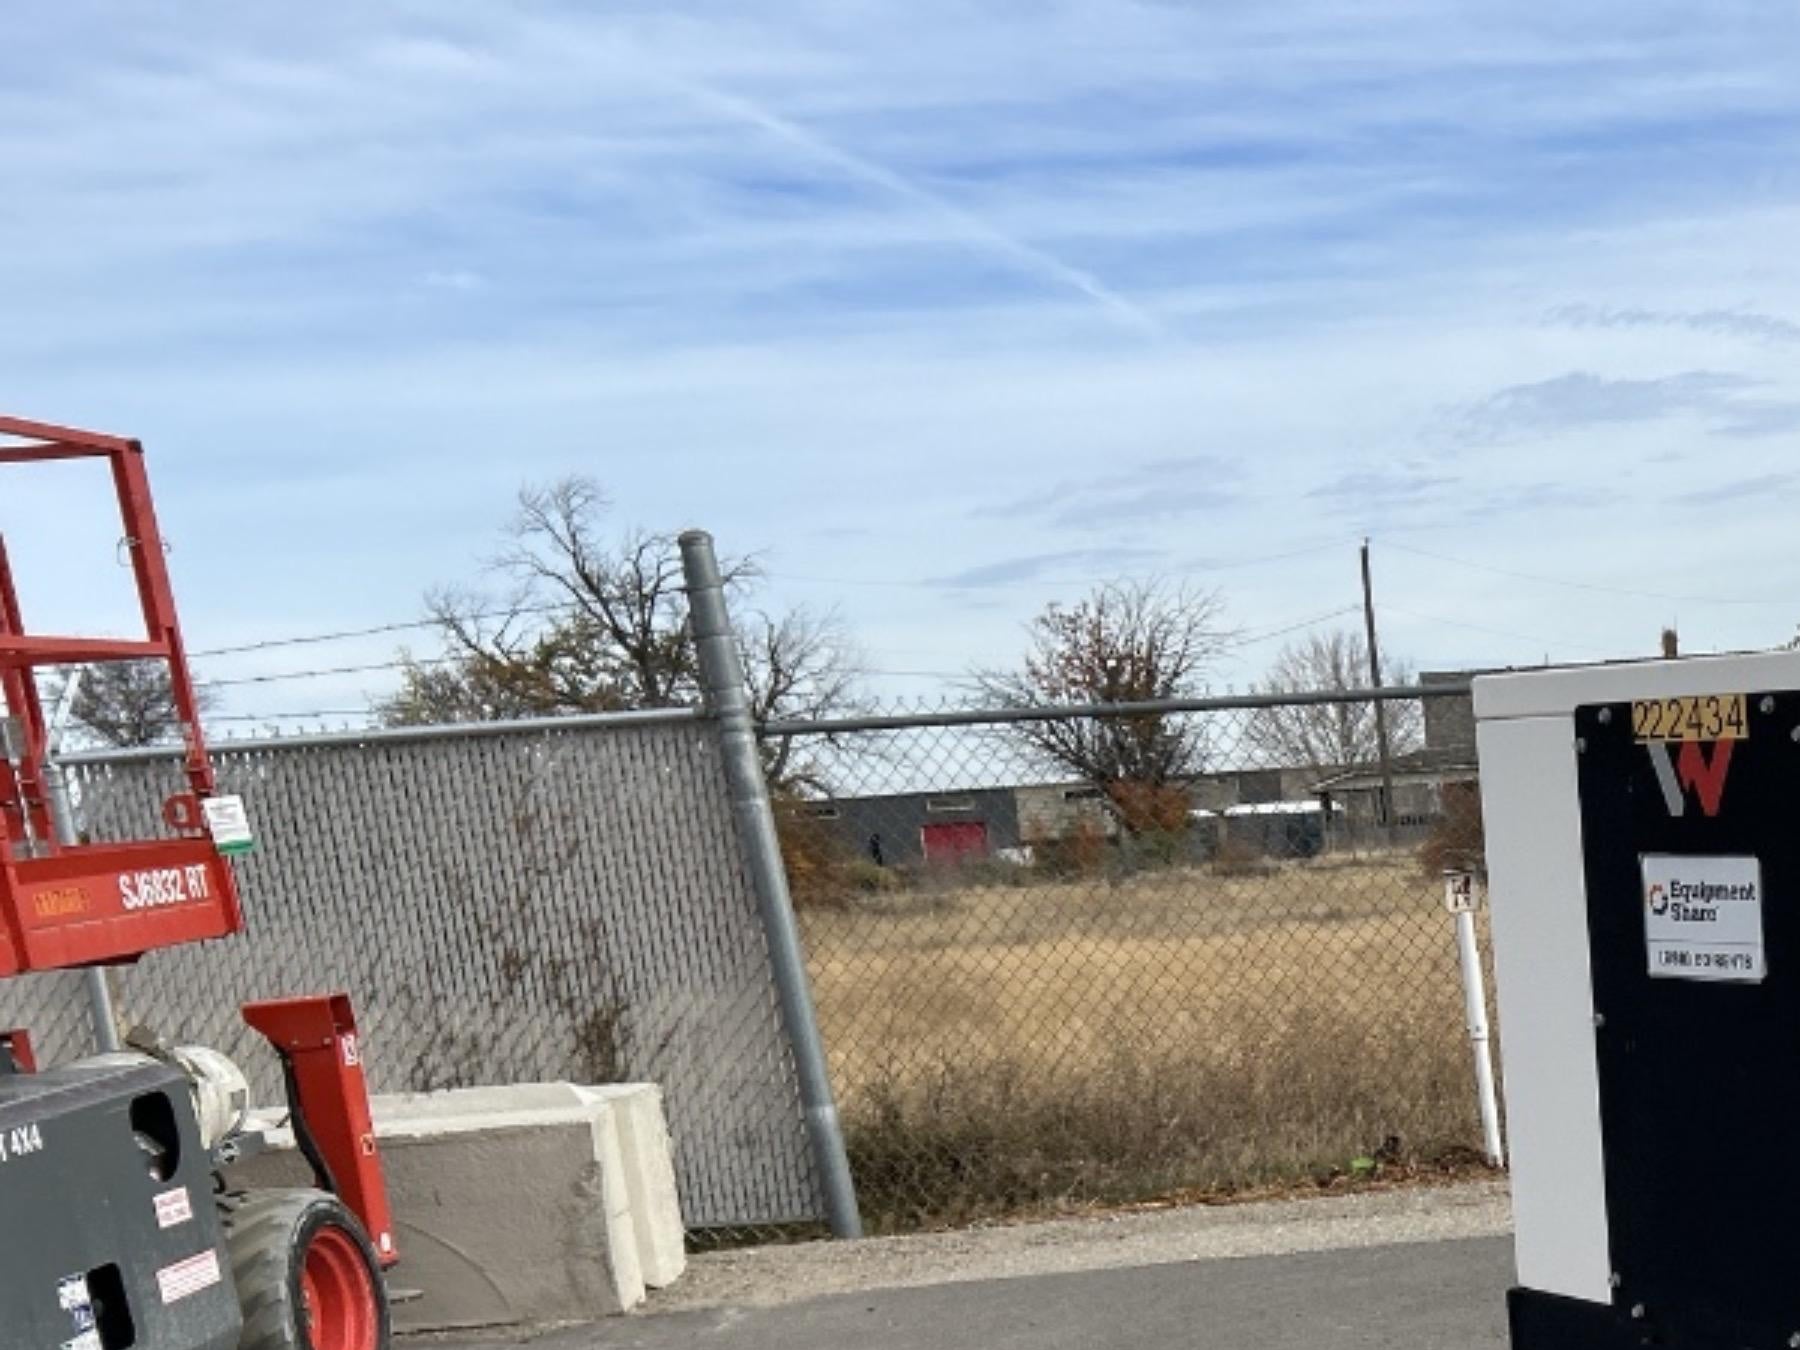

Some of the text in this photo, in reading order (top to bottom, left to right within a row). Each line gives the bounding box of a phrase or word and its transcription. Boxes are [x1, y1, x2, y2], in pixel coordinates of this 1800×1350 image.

[1634, 694, 1744, 739] 222434
[119, 869, 186, 910] SJ6832
[1670, 879, 1756, 904] Equipment
